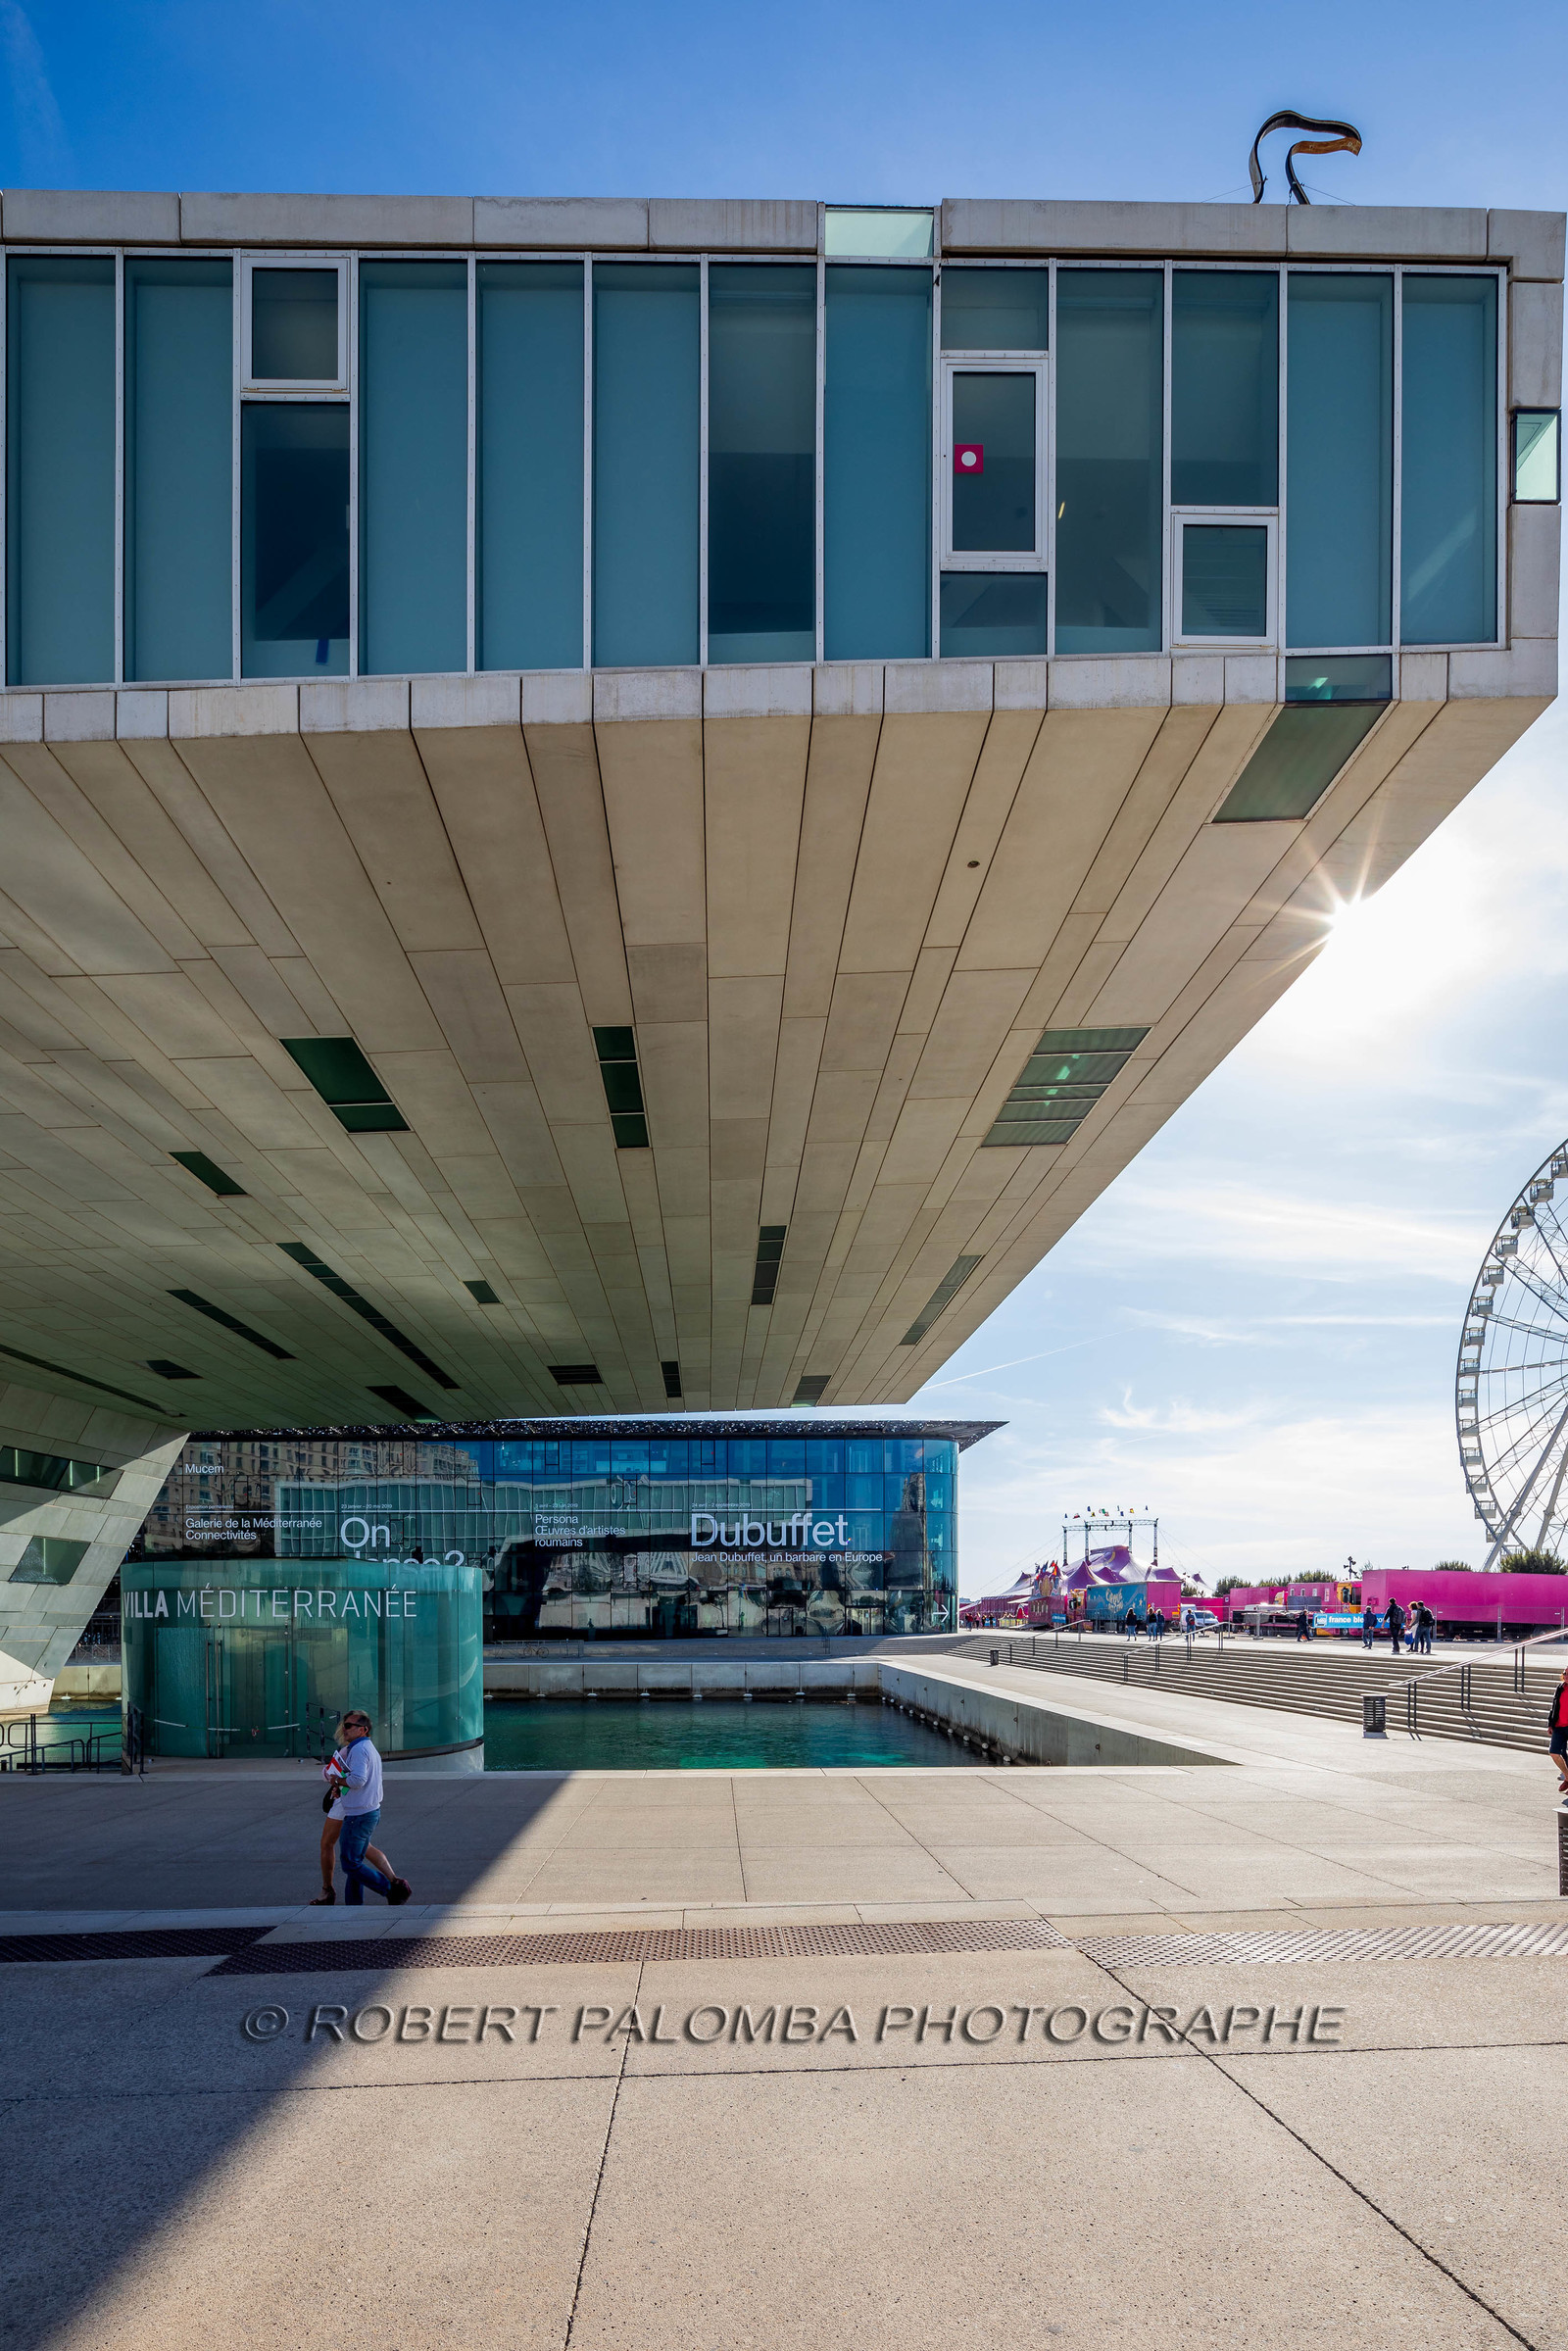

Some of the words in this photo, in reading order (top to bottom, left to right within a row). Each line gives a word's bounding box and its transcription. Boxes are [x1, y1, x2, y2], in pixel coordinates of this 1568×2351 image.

[185, 1464, 224, 1474] Mucem
[185, 1518, 222, 1528] Galerie
[225, 1518, 239, 1528] de
[241, 1518, 251, 1528] la
[253, 1518, 322, 1528] Méditerranée
[535, 1514, 579, 1524] Persona
[340, 1517, 390, 1548] On
[535, 1526, 576, 1536] Œuvres
[578, 1526, 626, 1536] d'artistes
[691, 1512, 849, 1547] Dubuffet
[185, 1530, 257, 1540] Connectivités
[535, 1539, 583, 1547] roumains
[691, 1552, 717, 1562] Jean
[719, 1552, 767, 1564] Dubuffet,
[785, 1552, 826, 1562] barbare
[845, 1552, 883, 1564] Europe
[176, 1582, 416, 1618] MÉDITERRANÉE
